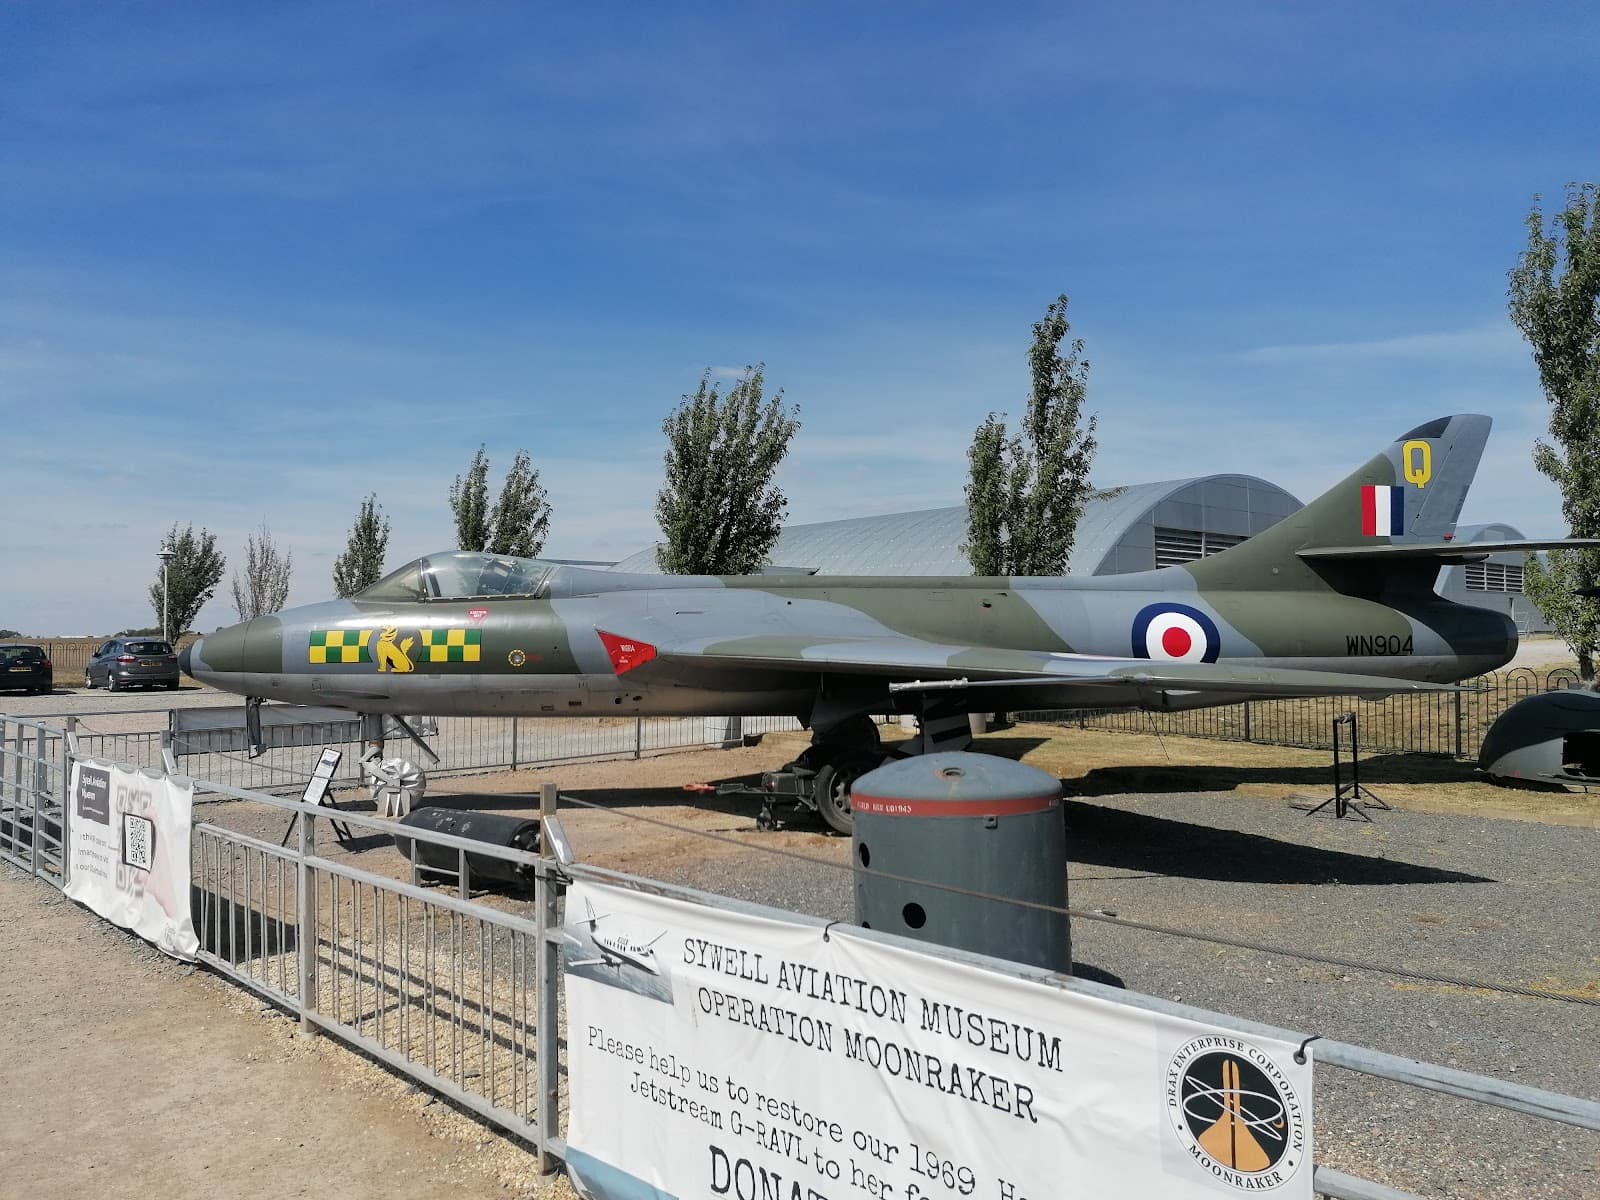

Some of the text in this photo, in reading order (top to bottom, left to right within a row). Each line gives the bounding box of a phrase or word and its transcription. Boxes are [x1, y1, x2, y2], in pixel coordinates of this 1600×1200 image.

[1402, 439, 1432, 489] Q
[1346, 634, 1414, 657] WN904
[683, 938, 1063, 1072] SYWELL AVIATION MUSEUM
[698, 987, 1038, 1123] OPERATION MOONRAKER
[588, 1026, 1028, 1200] Please help us to restore our 1969 H
[631, 1072, 930, 1200] Jetstream G-RAVL to her f
[1168, 1037, 1303, 1152] DRAX ENTERPRISE CORPORATION
[708, 1144, 829, 1200] DON
[1188, 1143, 1283, 1189] MOONRAKER
